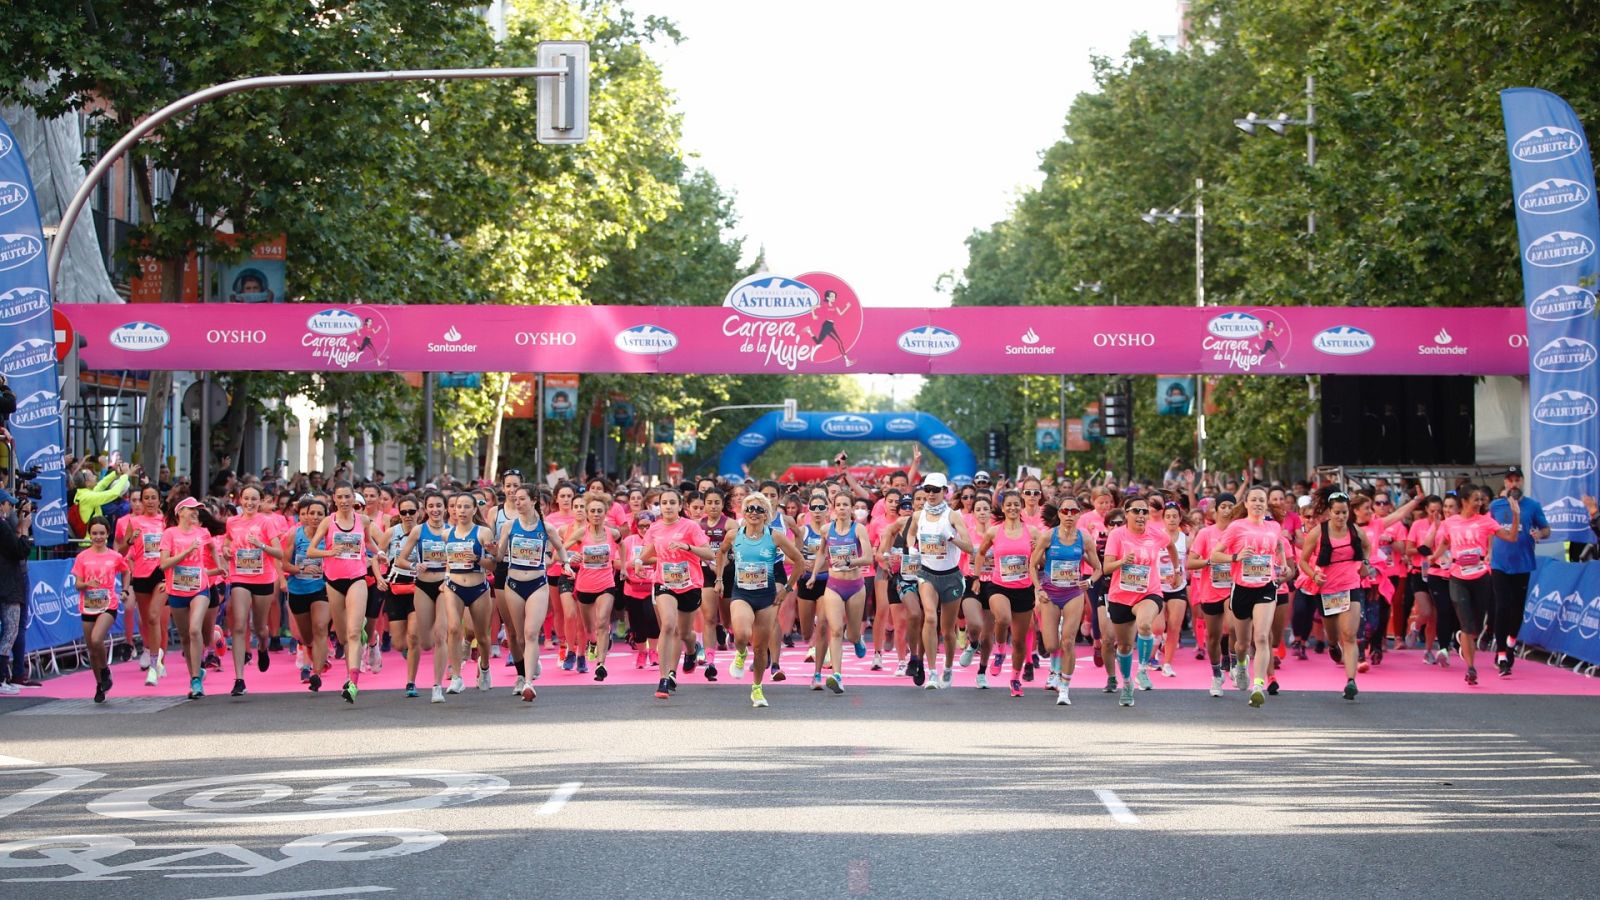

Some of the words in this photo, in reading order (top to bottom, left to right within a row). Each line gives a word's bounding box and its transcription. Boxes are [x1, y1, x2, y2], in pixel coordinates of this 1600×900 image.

[738, 292, 812, 308] ASTURIANA
[312, 319, 359, 329] ASTURIANA
[722, 315, 796, 336] Carrera
[1213, 322, 1259, 332] ASTURIANA
[114, 333, 165, 343] ASTURIANA
[207, 330, 267, 343] OYSHO
[301, 332, 347, 346] Carrera
[515, 332, 576, 345] OYSHO
[623, 336, 673, 347] ASTURIANA
[903, 336, 955, 348] ASTURIANA
[1093, 334, 1155, 346] OYSHO
[1318, 337, 1370, 348] ASTURIANA
[428, 342, 477, 352] Santander
[1202, 336, 1249, 350] Carrera
[740, 338, 754, 352] de
[756, 338, 766, 353] la
[764, 335, 822, 370] Mujer
[1005, 345, 1056, 354] Santander
[1418, 345, 1468, 355] Santander
[312, 349, 321, 357] de
[322, 348, 329, 357] la
[327, 345, 364, 368] Mujer
[1214, 352, 1222, 361] de
[1224, 351, 1231, 360] la
[1229, 349, 1266, 371] Mujer
